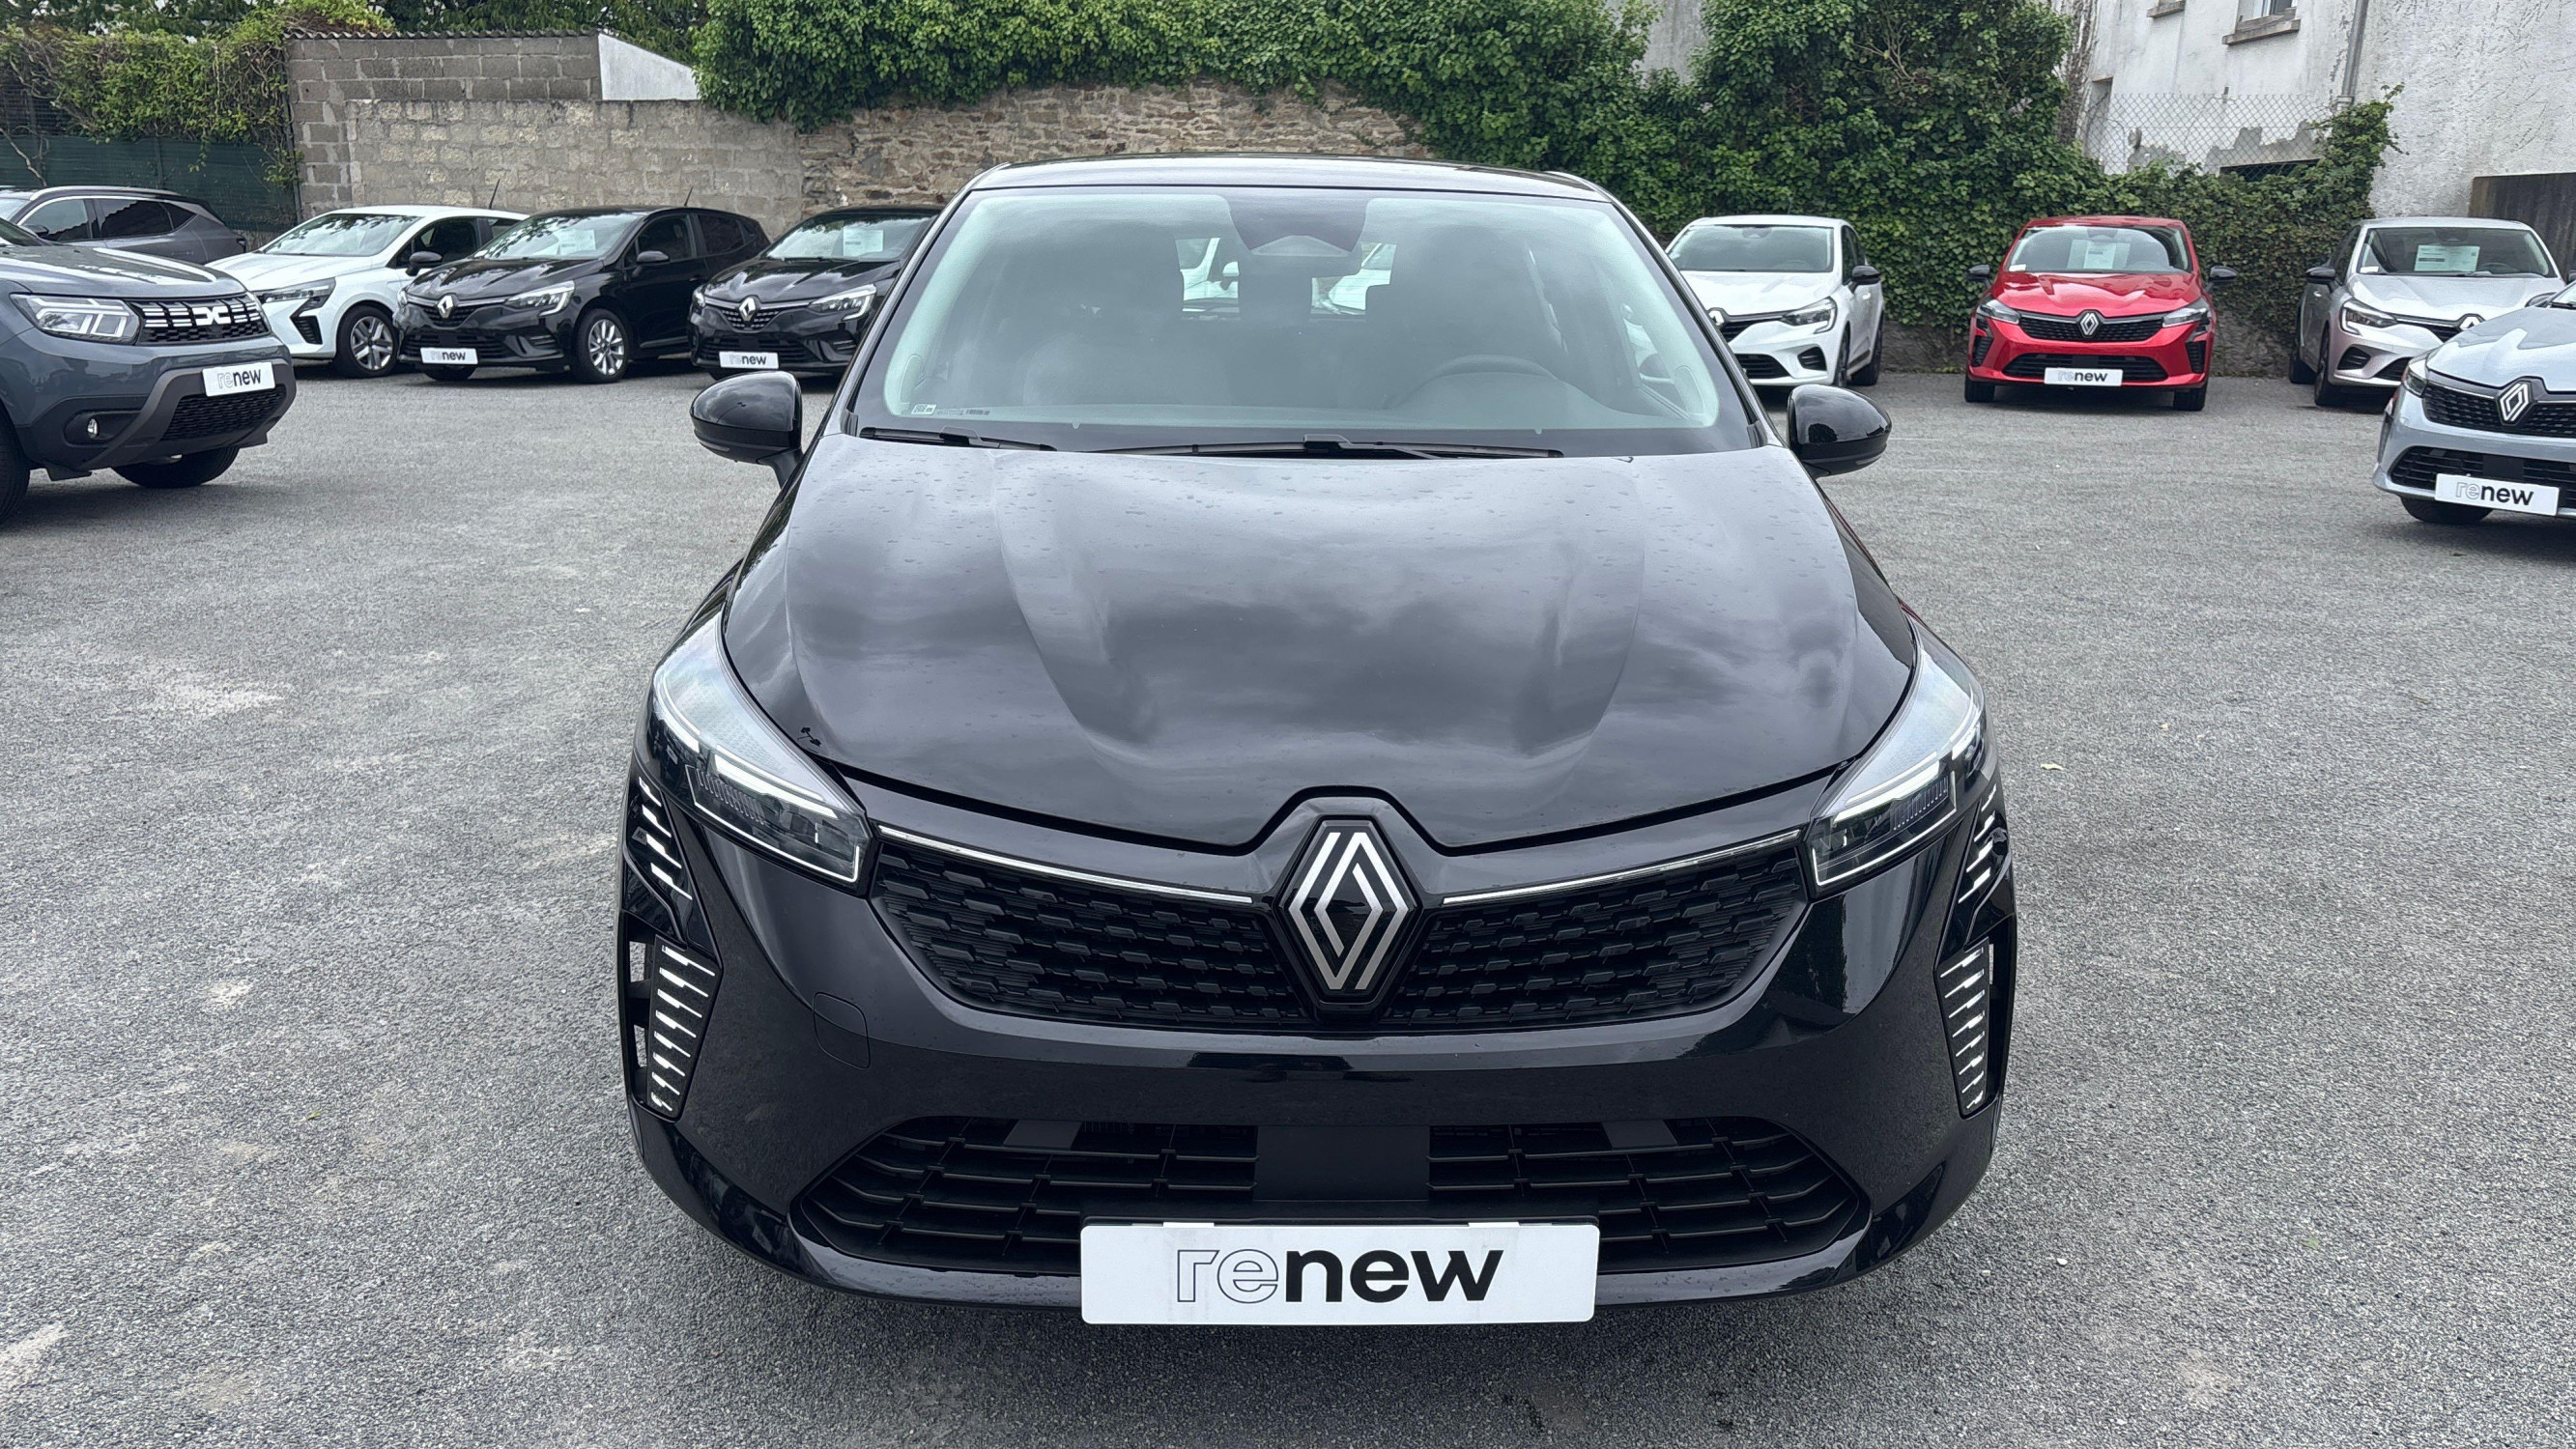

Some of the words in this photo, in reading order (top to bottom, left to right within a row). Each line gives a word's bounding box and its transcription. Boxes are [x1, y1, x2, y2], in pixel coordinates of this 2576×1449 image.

[430, 351, 466, 361] new
[217, 369, 261, 388] renew
[2455, 482, 2534, 506] renew
[1177, 1249, 1504, 1303] renew
